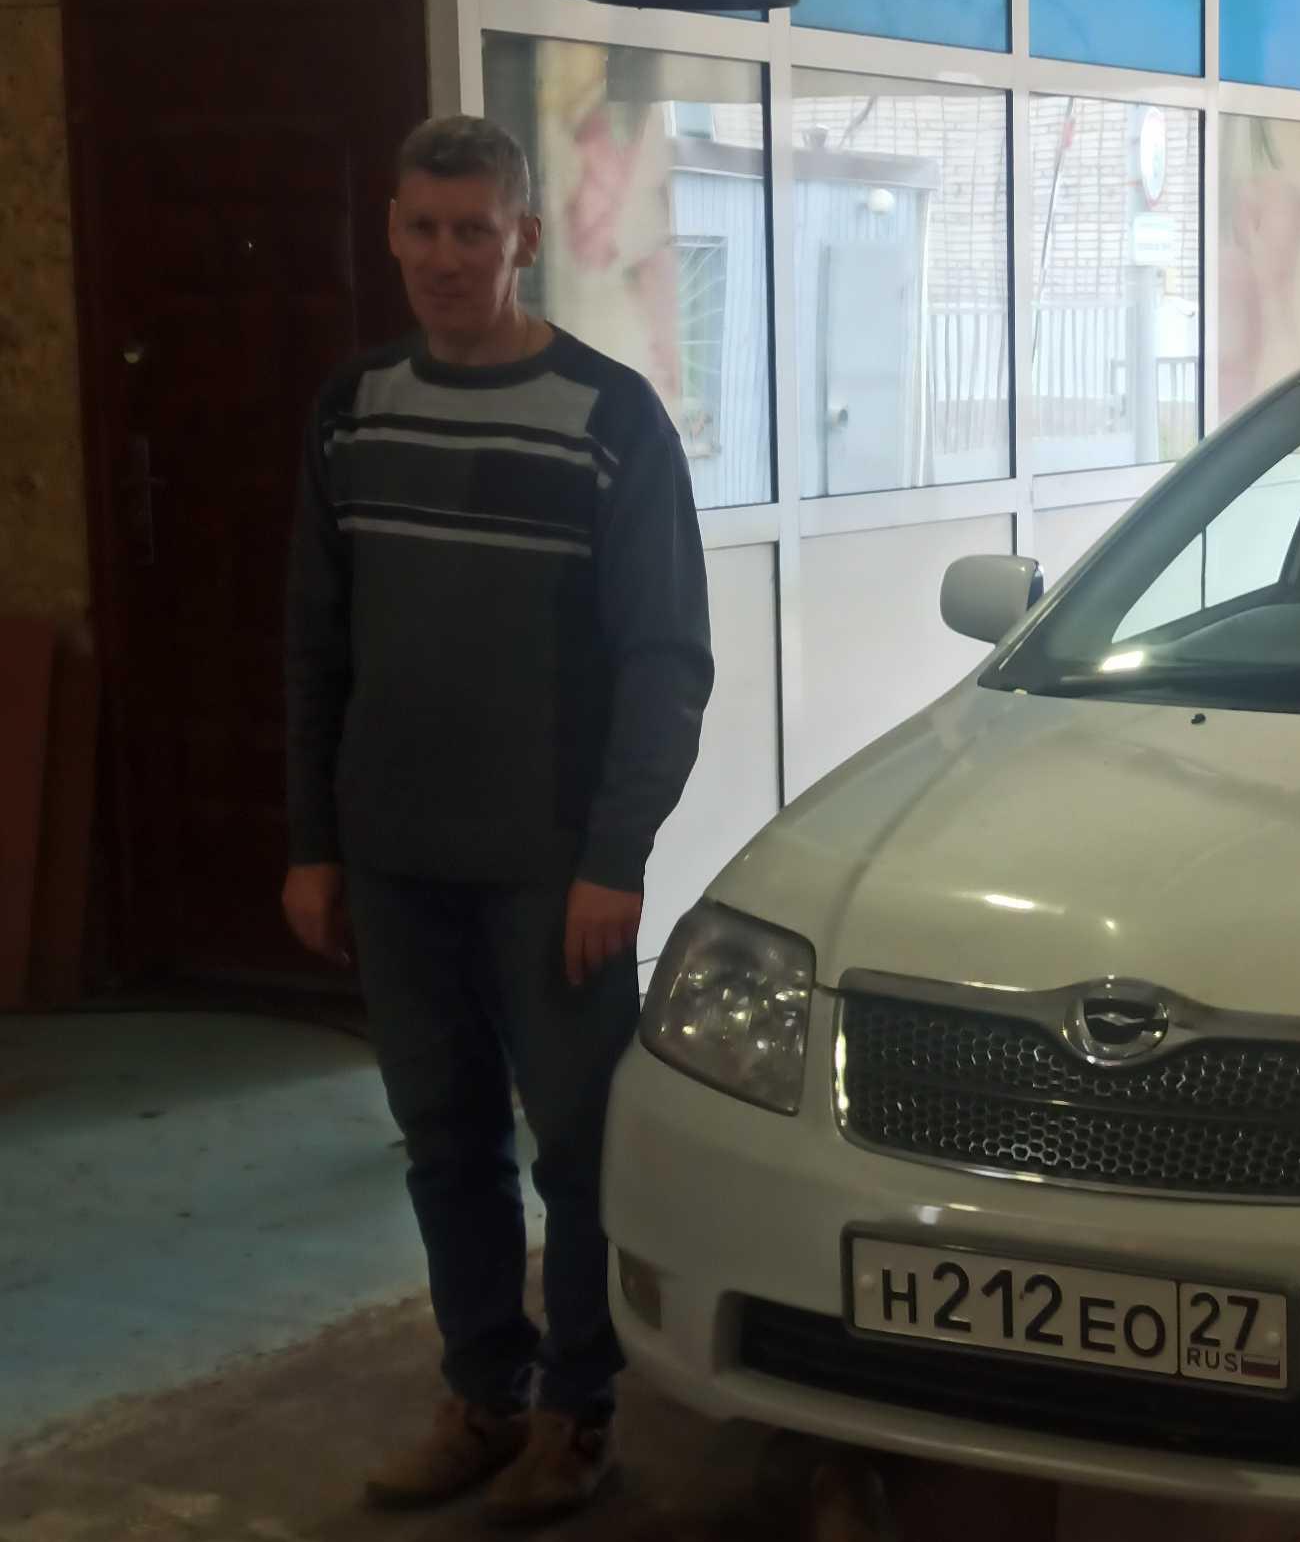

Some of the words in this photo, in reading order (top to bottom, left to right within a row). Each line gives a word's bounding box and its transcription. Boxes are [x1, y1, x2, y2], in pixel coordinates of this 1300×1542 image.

[881, 1261, 1167, 1358] Н212ЕО
[1189, 1291, 1260, 1351] 27
[1186, 1346, 1239, 1373] RUS
